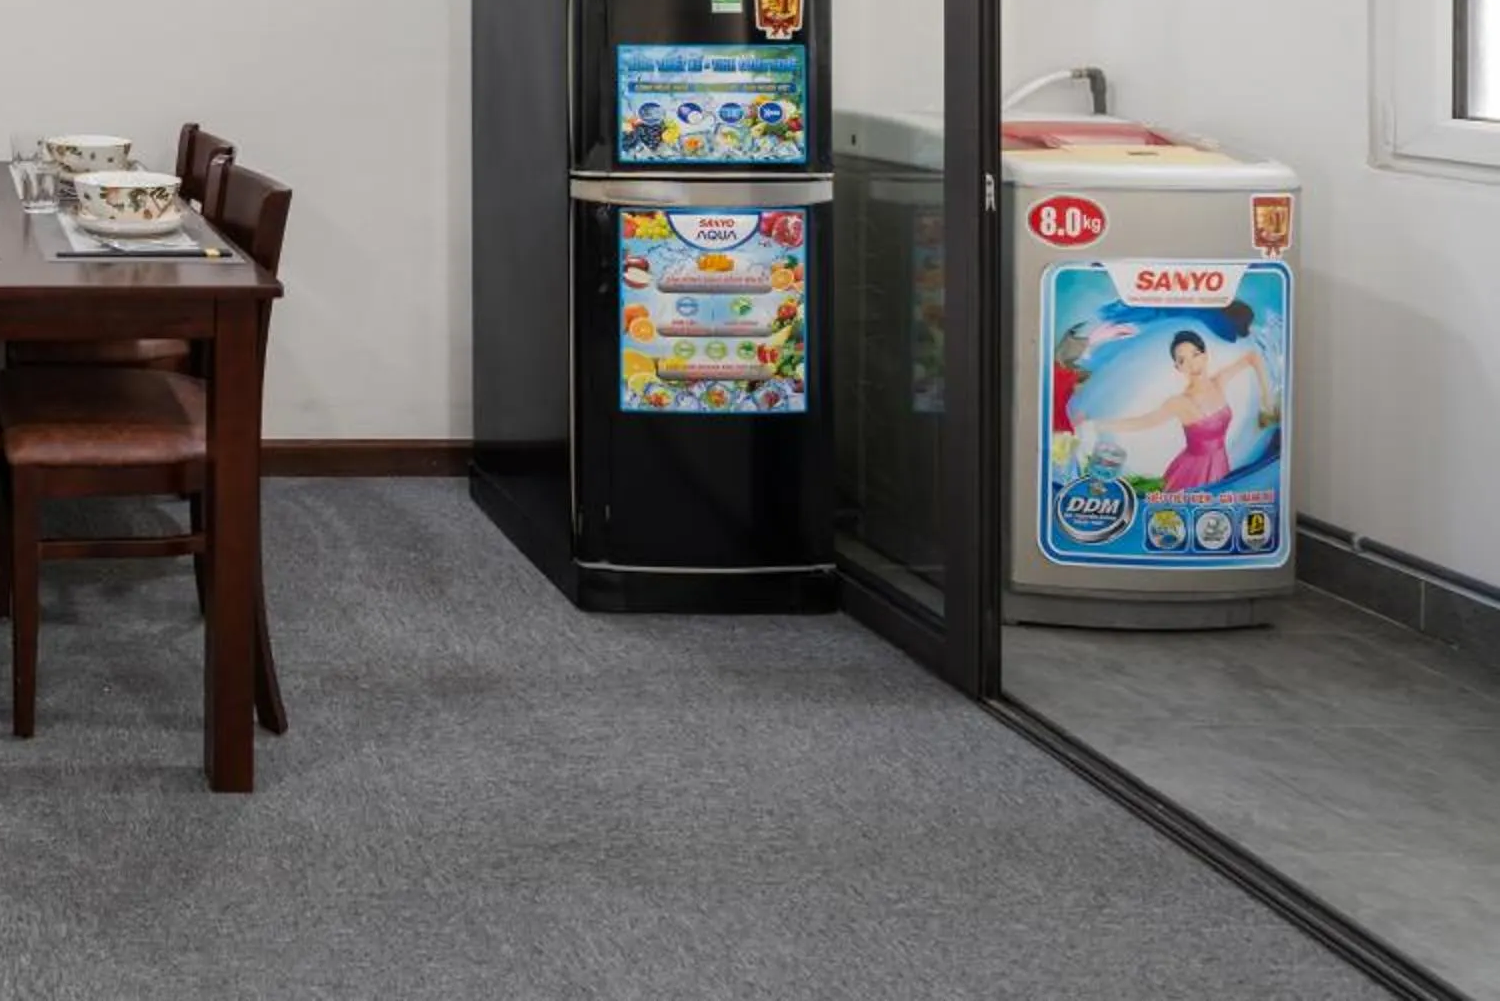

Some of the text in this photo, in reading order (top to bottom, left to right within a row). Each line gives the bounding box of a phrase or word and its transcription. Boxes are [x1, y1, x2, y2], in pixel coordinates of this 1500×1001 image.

[697, 230, 737, 240] AQUA
[1135, 270, 1224, 293] SANYO
[1066, 497, 1120, 514] DDM
